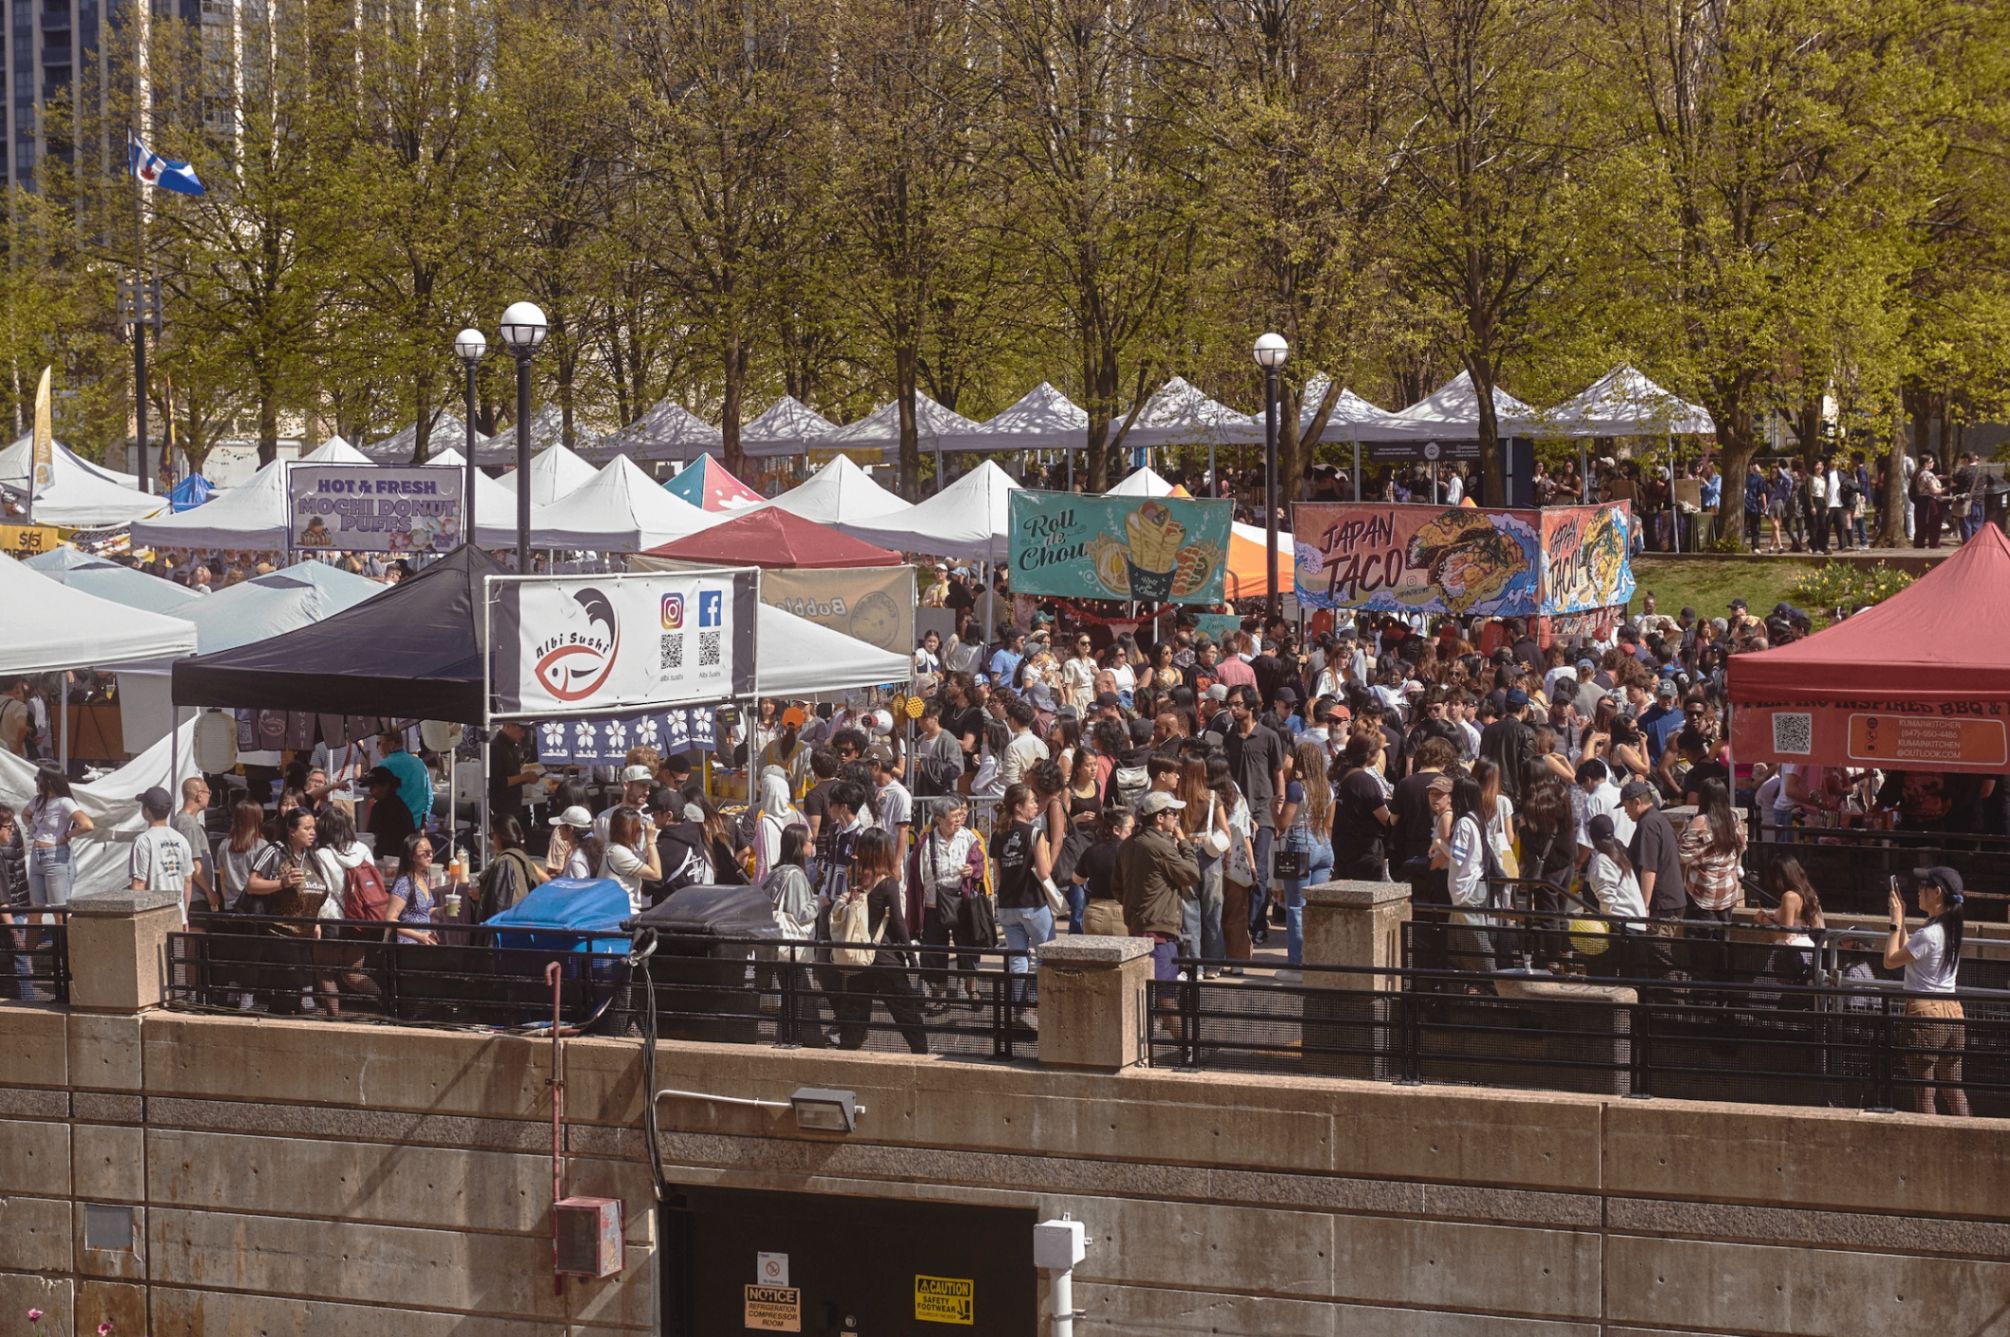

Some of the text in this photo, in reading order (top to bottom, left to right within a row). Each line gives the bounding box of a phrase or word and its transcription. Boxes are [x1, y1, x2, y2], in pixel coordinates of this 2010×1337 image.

[318, 479, 437, 494] HOT & FRESH
[299, 498, 457, 517] MOCHI DONUT
[340, 515, 412, 533] PUFFS
[1023, 508, 1077, 537] Roll
[1318, 511, 1395, 554] JAPAN
[1549, 513, 1580, 555] JAPAN
[1322, 548, 1404, 601] TACO
[1549, 549, 1579, 605] TACO
[536, 632, 610, 659] Albi Sushi
[1939, 702, 1983, 715] BBQ
[1897, 749, 1961, 759] @OUTLOOK.COM
[749, 1287, 795, 1302] NOTICE
[930, 1280, 969, 1296] CAUTION
[923, 1295, 949, 1304] SAFETY
[748, 1303, 796, 1313] REFRIGERATION
[917, 1302, 956, 1313] FOOTWEAR
[748, 1311, 798, 1321] COMPRESSOR
[762, 1319, 784, 1327] ROOM
